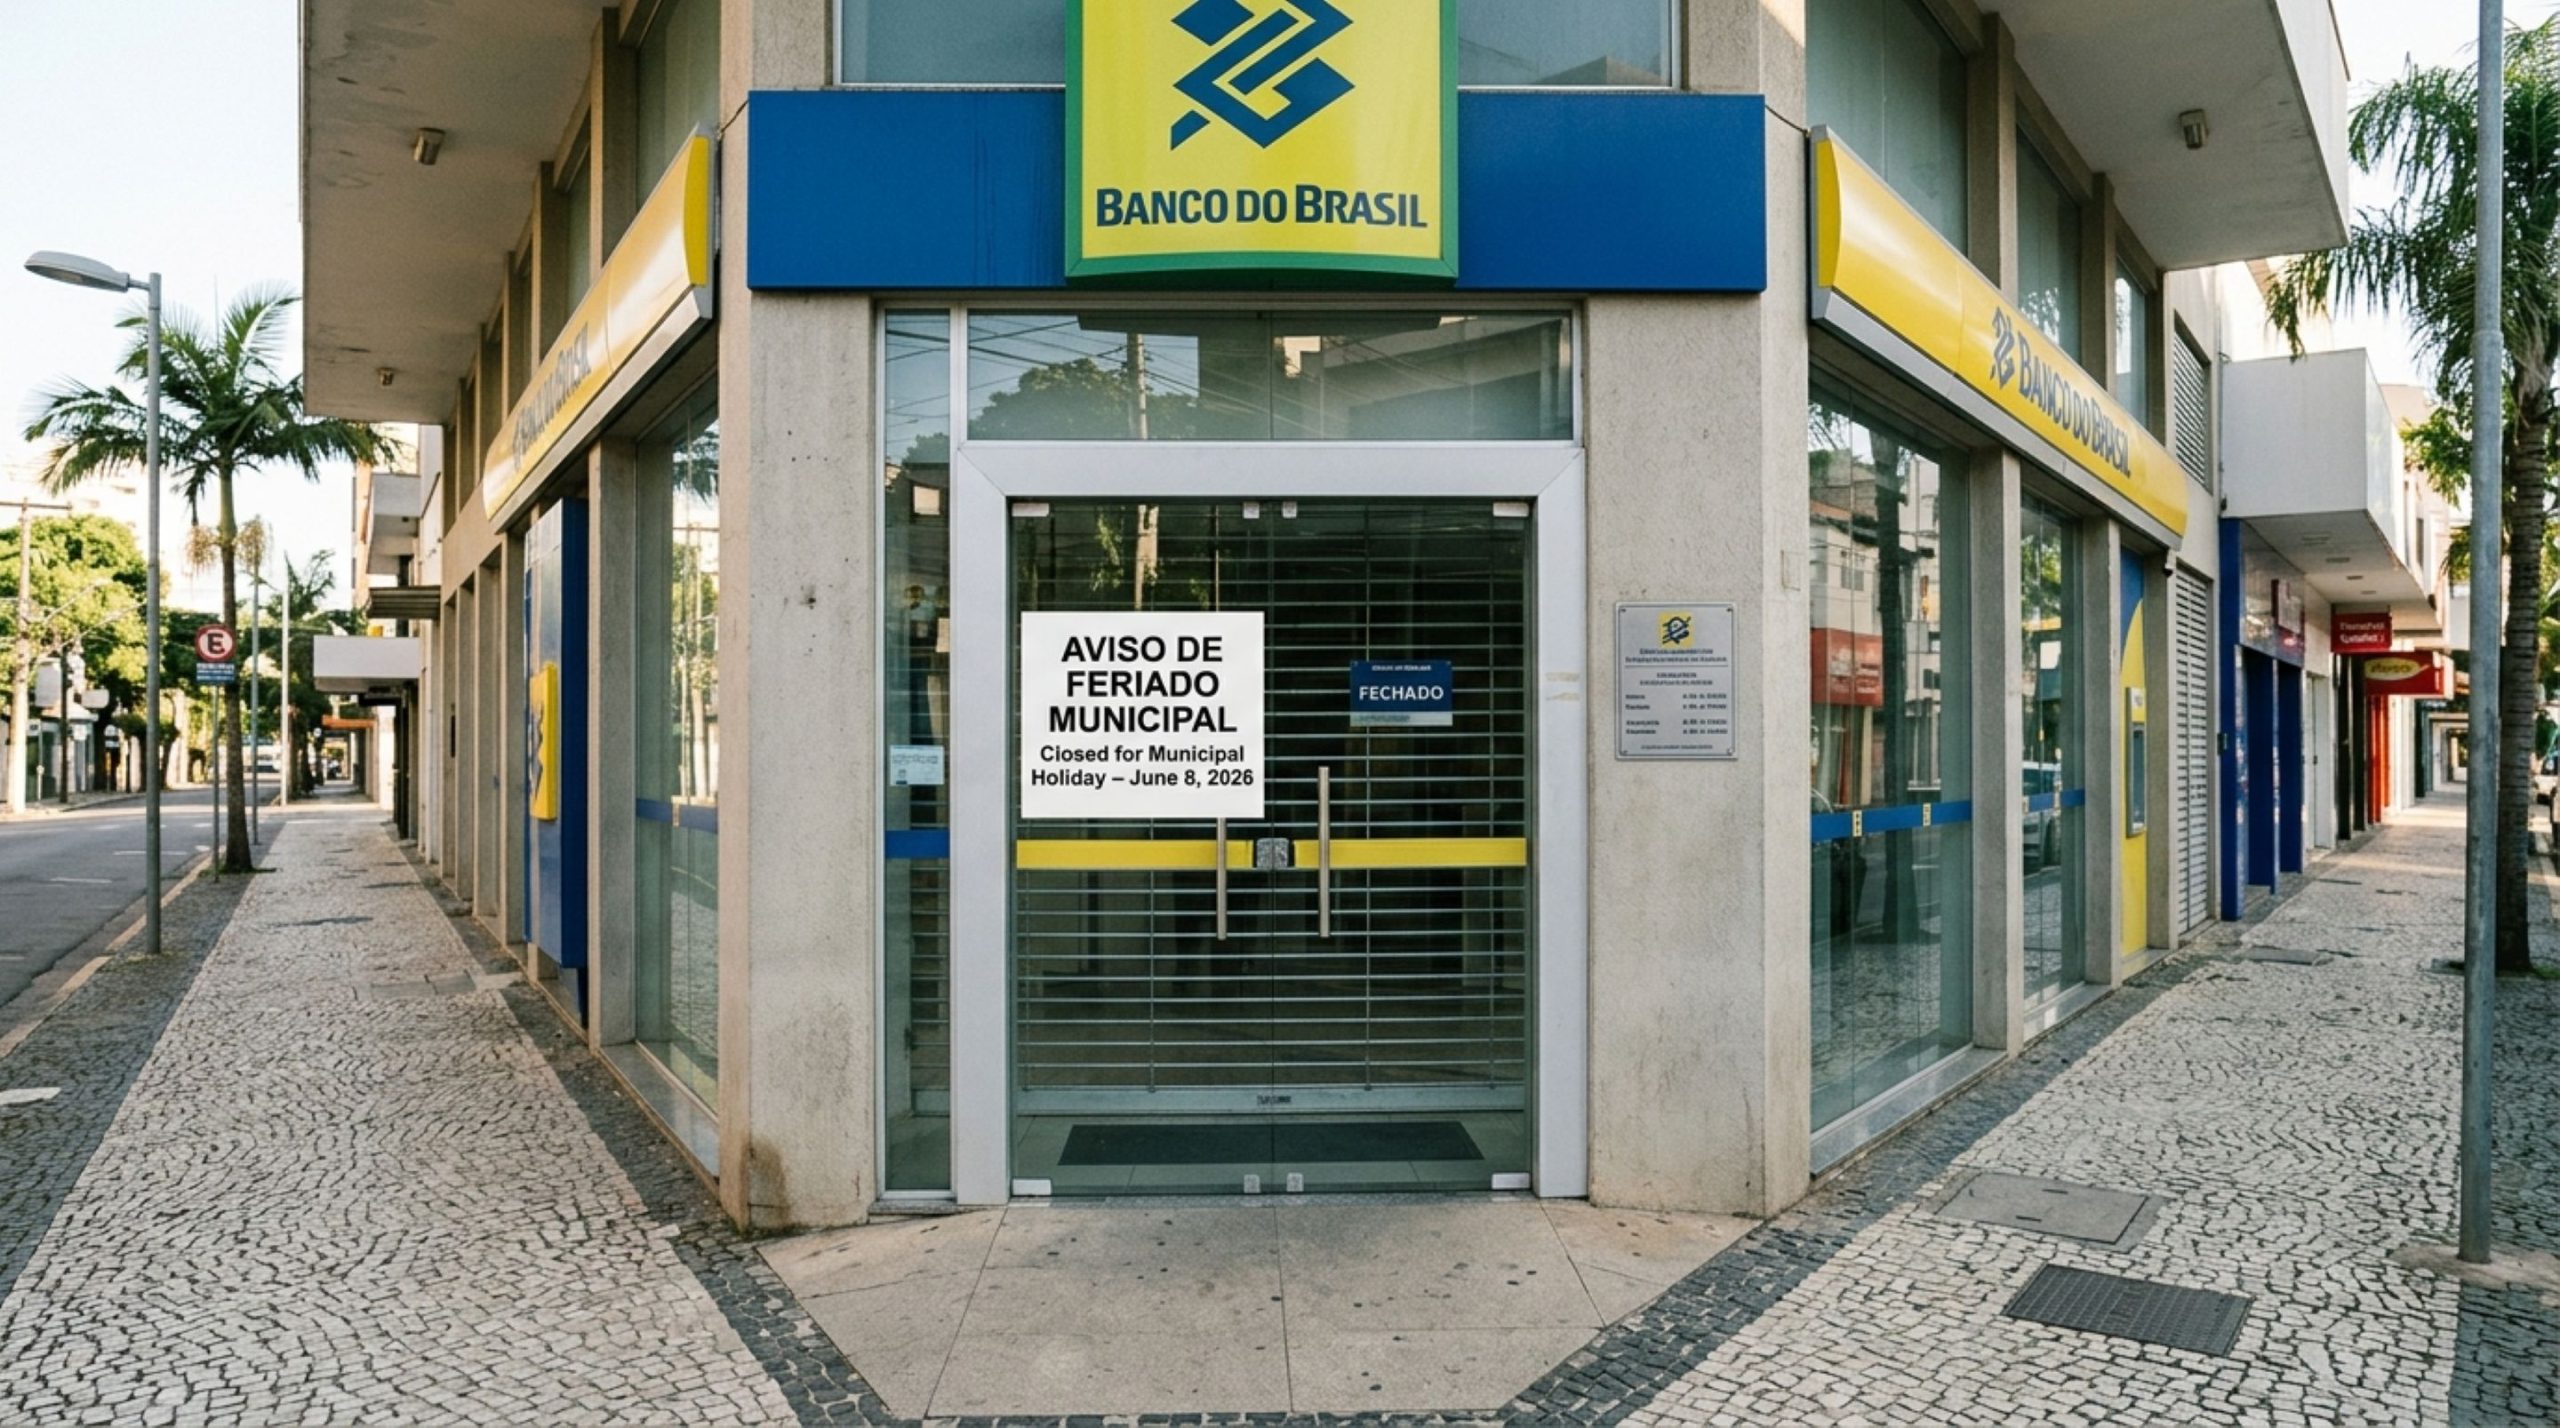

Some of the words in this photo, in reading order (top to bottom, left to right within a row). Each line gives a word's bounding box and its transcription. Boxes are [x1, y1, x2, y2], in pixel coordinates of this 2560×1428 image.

[1096, 187, 1228, 227] BANCO
[1236, 189, 1288, 224] DO
[1295, 184, 1428, 228] BRASIL
[2017, 330, 2071, 430] BANCO
[2073, 390, 2091, 446] DO
[207, 633, 226, 655] E
[1061, 635, 1166, 663] AVISO
[1176, 636, 1223, 662] DE
[1067, 670, 1220, 698] FERIADO
[1358, 685, 1444, 701] FECHADO
[1049, 705, 1238, 733] MUNICIPAL
[1115, 745, 1143, 762] for
[1148, 745, 1244, 766] Municipal
[1031, 769, 1106, 790] Holiday
[1129, 769, 1178, 786] June
[1184, 769, 1201, 788] 8,
[1207, 769, 1254, 786] 2026
